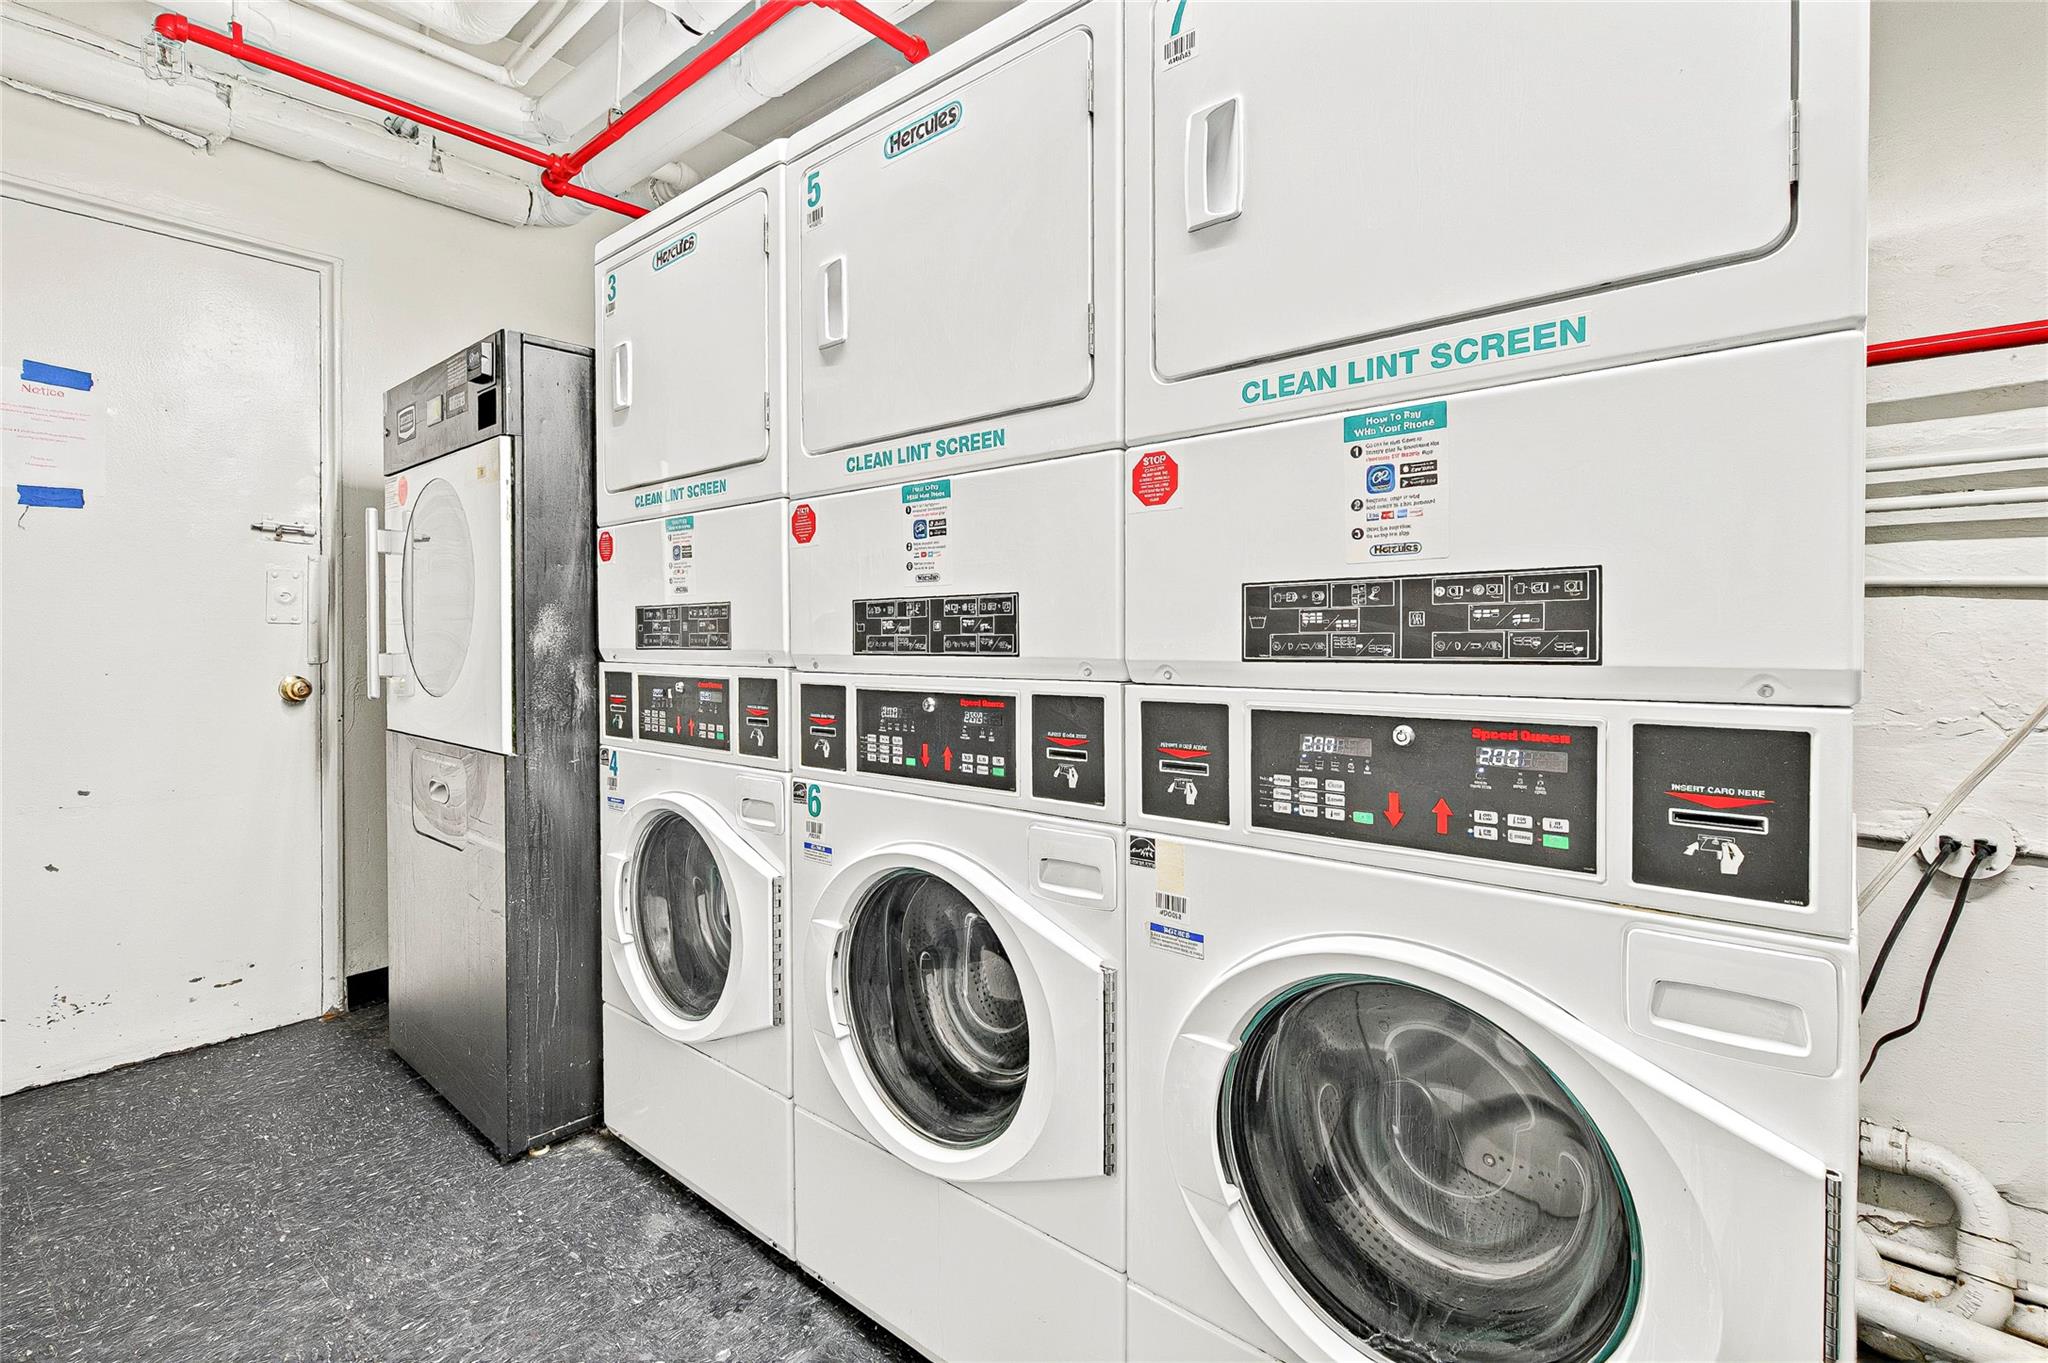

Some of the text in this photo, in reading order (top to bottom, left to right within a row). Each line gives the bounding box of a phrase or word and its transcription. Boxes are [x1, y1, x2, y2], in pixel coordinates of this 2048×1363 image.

[1167, 0, 1187, 36] 7
[889, 107, 957, 154] Hercules
[807, 170, 821, 208] 5
[656, 235, 695, 268] Hercules
[607, 274, 616, 302] 3
[1241, 316, 1587, 404] CLEAN LINT SCREEN
[1365, 416, 1388, 426] How
[1390, 413, 1402, 421] To
[846, 428, 1005, 473] CLEAN LINT SCREEN
[1143, 455, 1166, 466] STOP
[634, 491, 663, 508] CLEAN
[687, 479, 727, 497] SCREEN
[1374, 544, 1419, 554] Hercules
[1471, 727, 1572, 744] Speed Queen
[609, 750, 618, 777] 4
[807, 783, 822, 818] 6
[1671, 783, 1706, 793] INSERT
